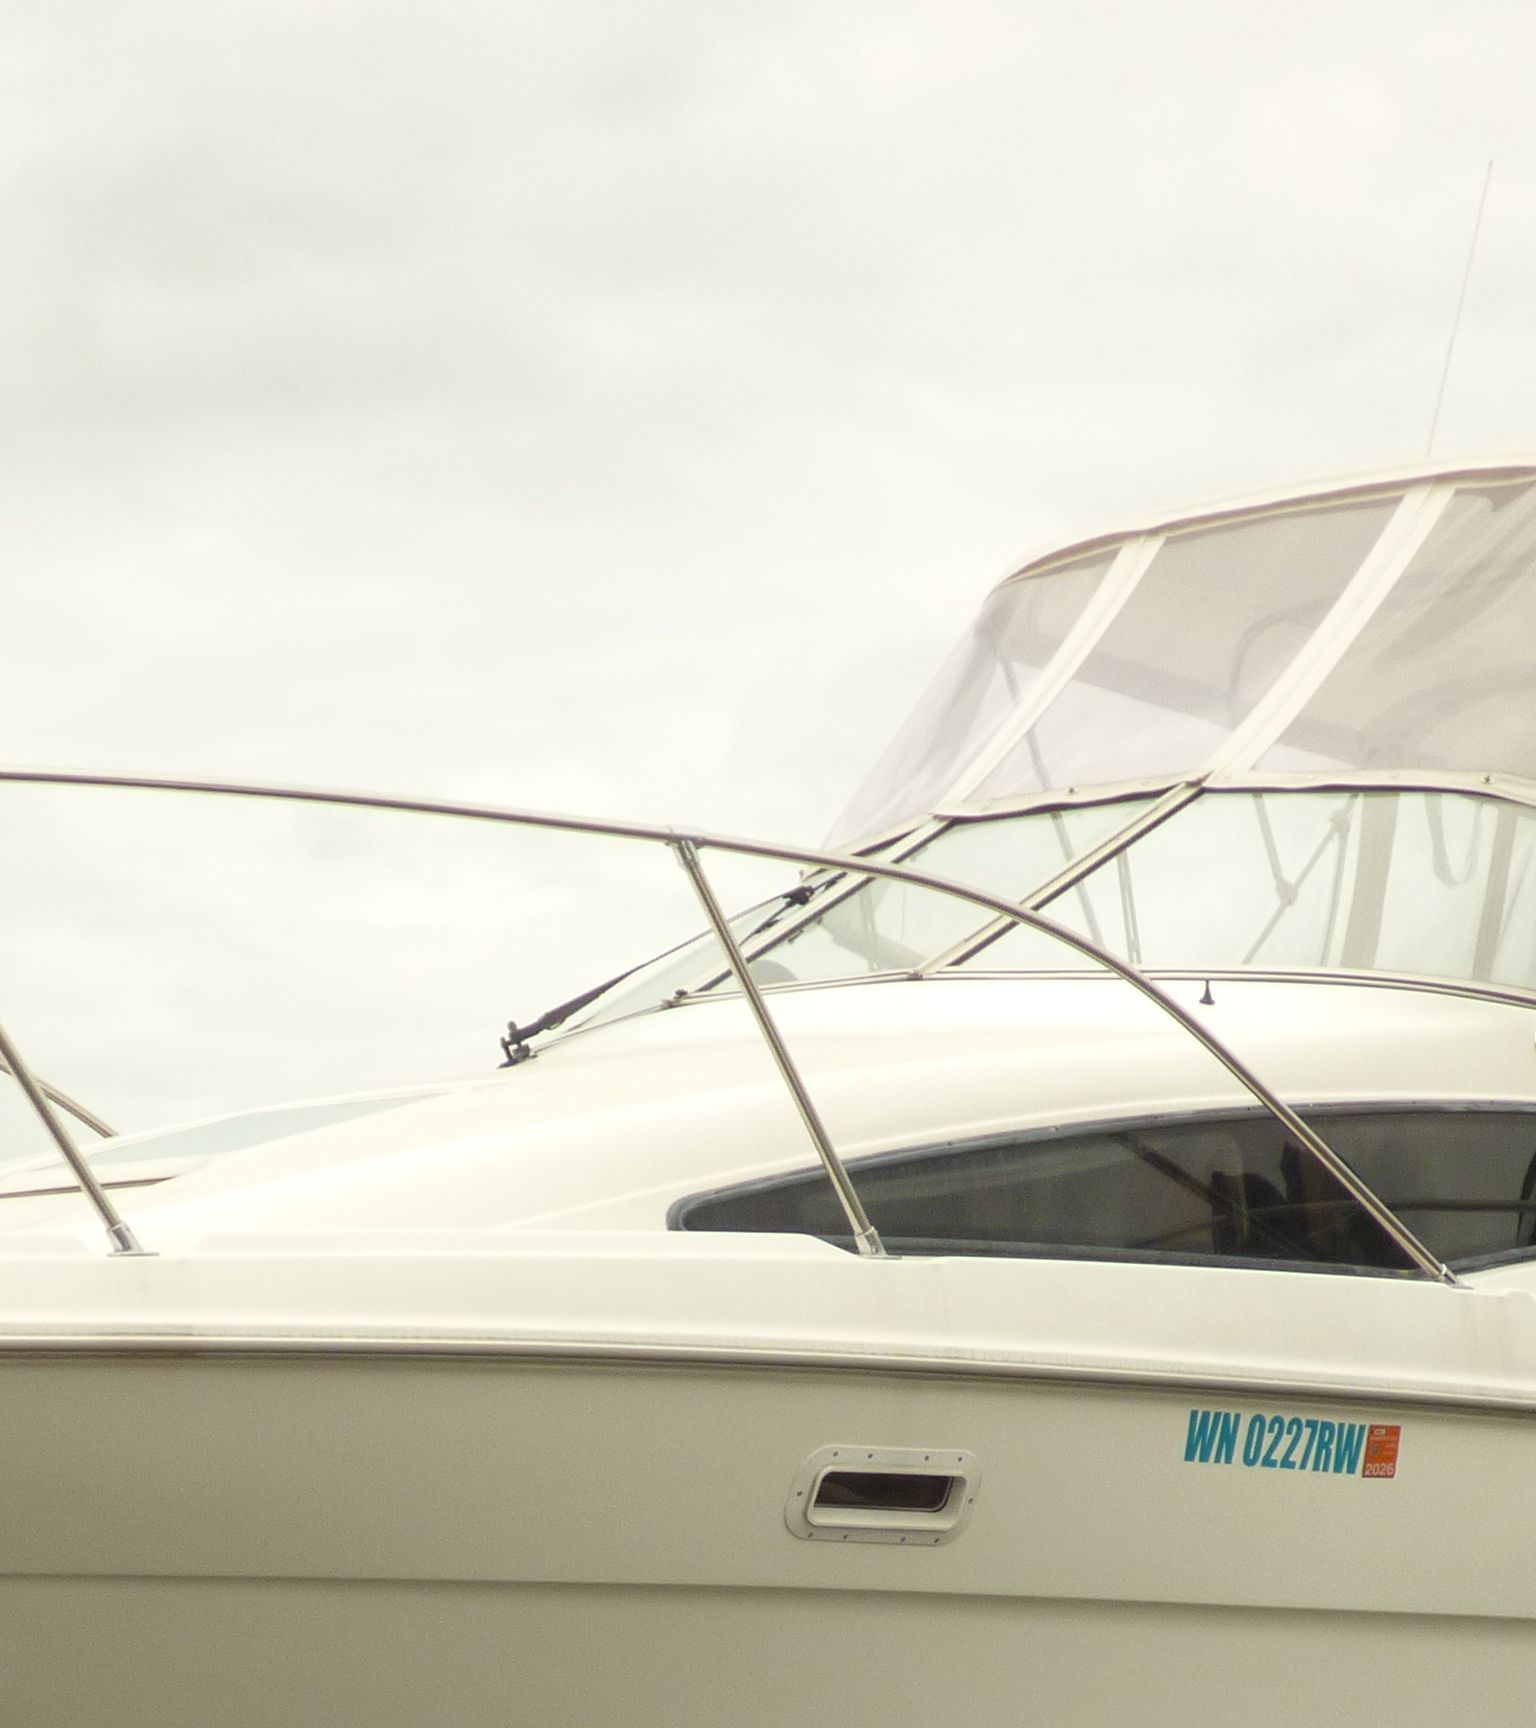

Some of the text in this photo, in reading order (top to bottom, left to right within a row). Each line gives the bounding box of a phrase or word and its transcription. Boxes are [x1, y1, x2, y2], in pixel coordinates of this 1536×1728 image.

[1184, 1409, 1241, 1464] WN
[1242, 1413, 1366, 1475] 0227RW
[1364, 1463, 1394, 1476] 2026
